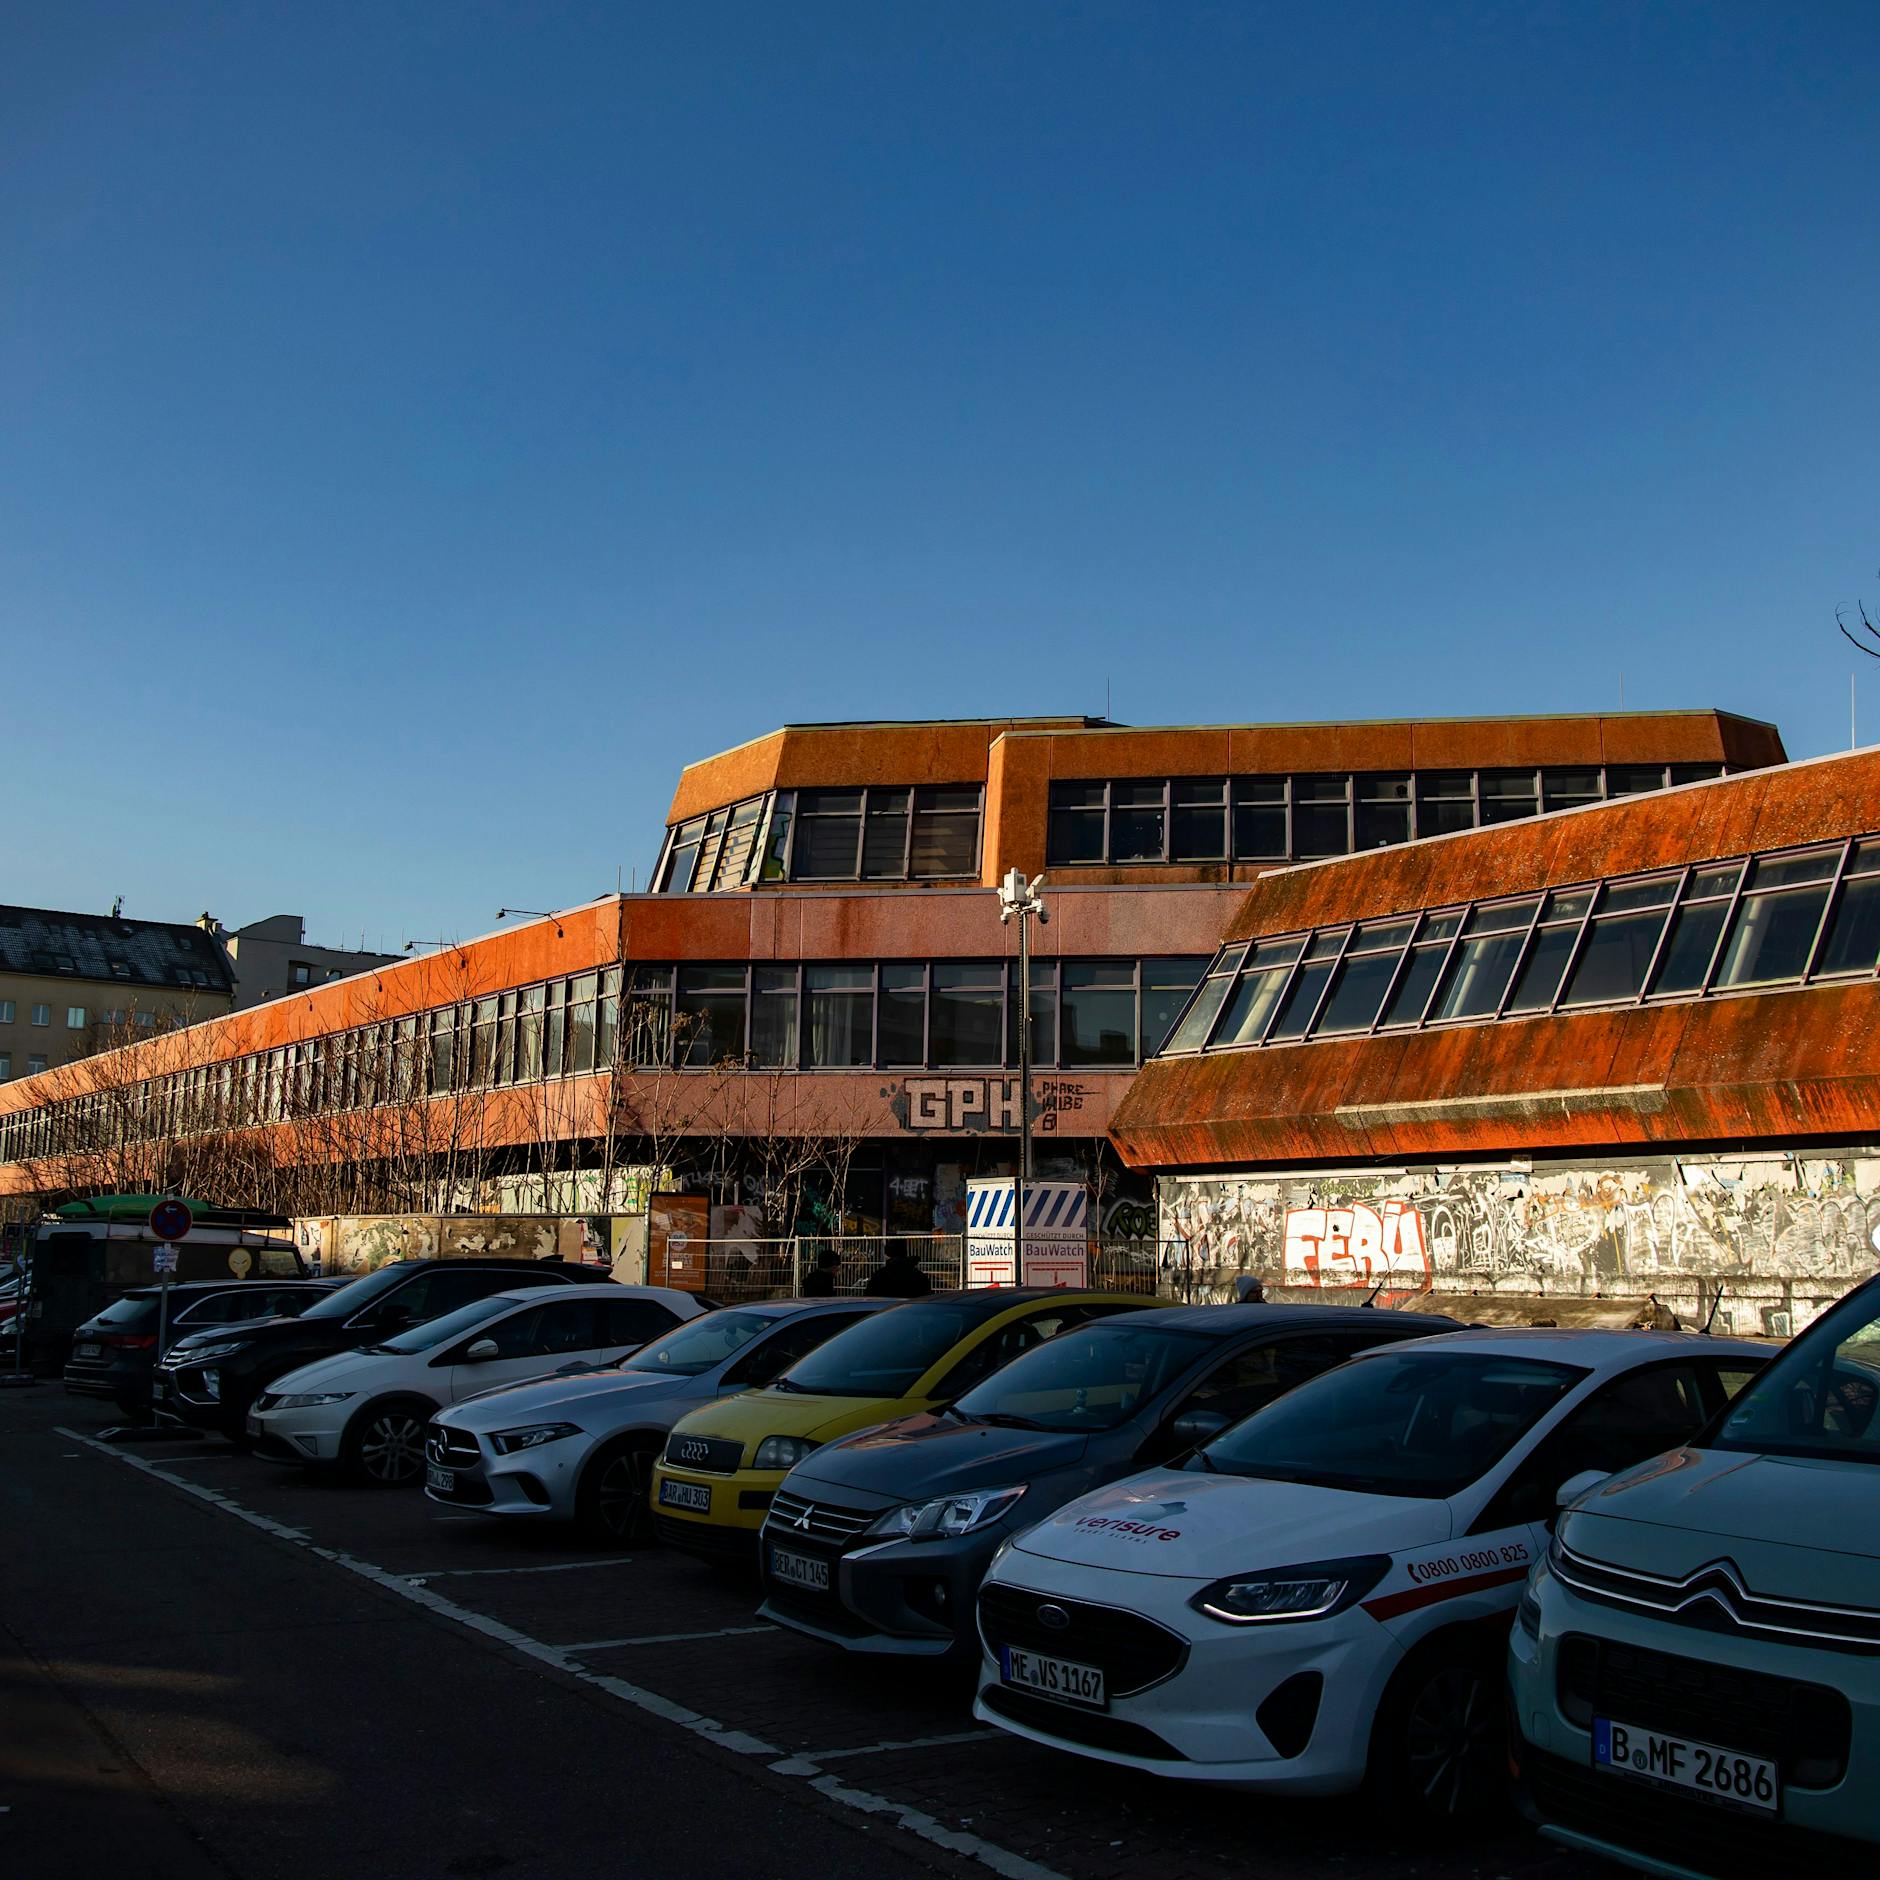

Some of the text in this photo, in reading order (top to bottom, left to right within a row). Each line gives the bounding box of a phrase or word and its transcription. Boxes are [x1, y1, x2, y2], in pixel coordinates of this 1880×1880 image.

[1062, 1232, 1084, 1240] DURCH
[970, 1243, 1013, 1256] BauWatch
[1026, 1243, 1084, 1256] BauWatch
[692, 1488, 708, 1507] 303
[1076, 1517, 1181, 1541] verisure
[796, 1558, 807, 1580] CT
[809, 1562, 828, 1586] 145
[1418, 1544, 1529, 1579] 0800 0800 825
[1010, 1651, 1029, 1681] ME
[1038, 1659, 1058, 1690] VS
[1061, 1665, 1101, 1699] 1167
[1612, 1726, 1629, 1763] B
[1649, 1736, 1687, 1777] MF
[1694, 1749, 1773, 1801] 2686
